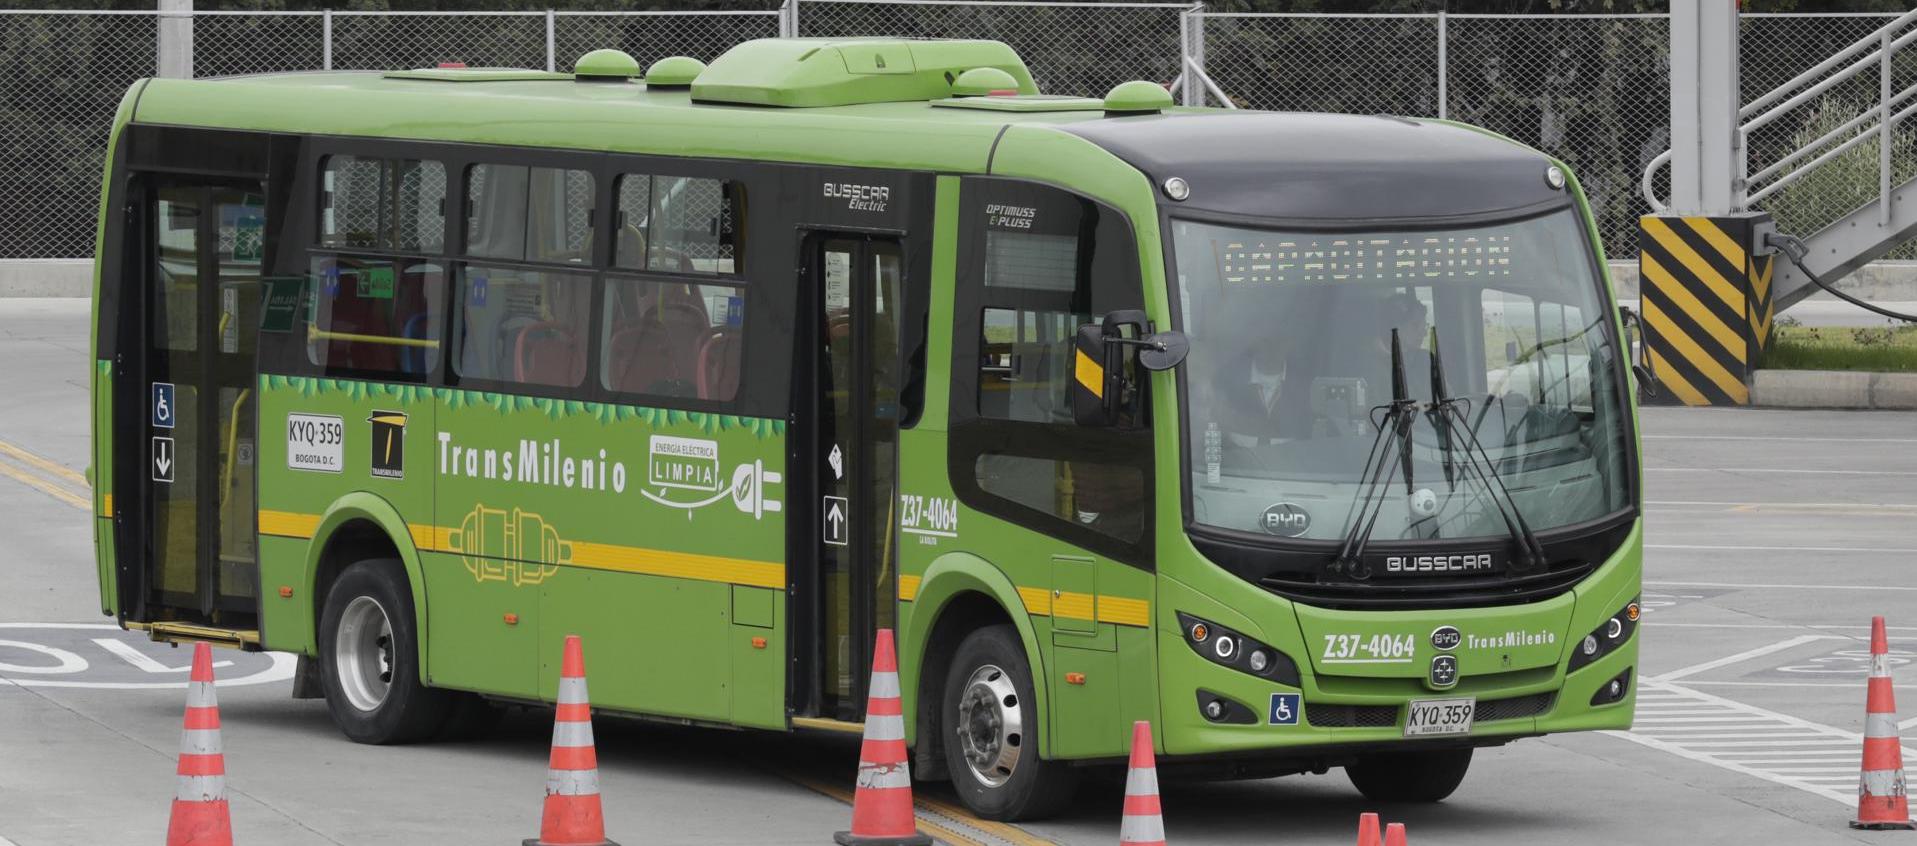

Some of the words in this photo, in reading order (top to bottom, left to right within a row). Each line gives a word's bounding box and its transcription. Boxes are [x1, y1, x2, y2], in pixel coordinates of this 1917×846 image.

[823, 182, 889, 201] BUSSCAR
[848, 198, 887, 212] Electric
[986, 204, 1037, 218] OPTIMUSS
[296, 454, 321, 464] BOGOTA
[438, 432, 627, 493] TransMilenio
[655, 461, 712, 484] LIMPIA
[901, 494, 958, 531] Z37-4064
[1266, 513, 1306, 528] BYD
[1387, 554, 1492, 572] BUSSCAR
[1323, 634, 1415, 659] Z37-4064
[1433, 633, 1459, 644] BYD
[1468, 630, 1555, 649] TransMilenio
